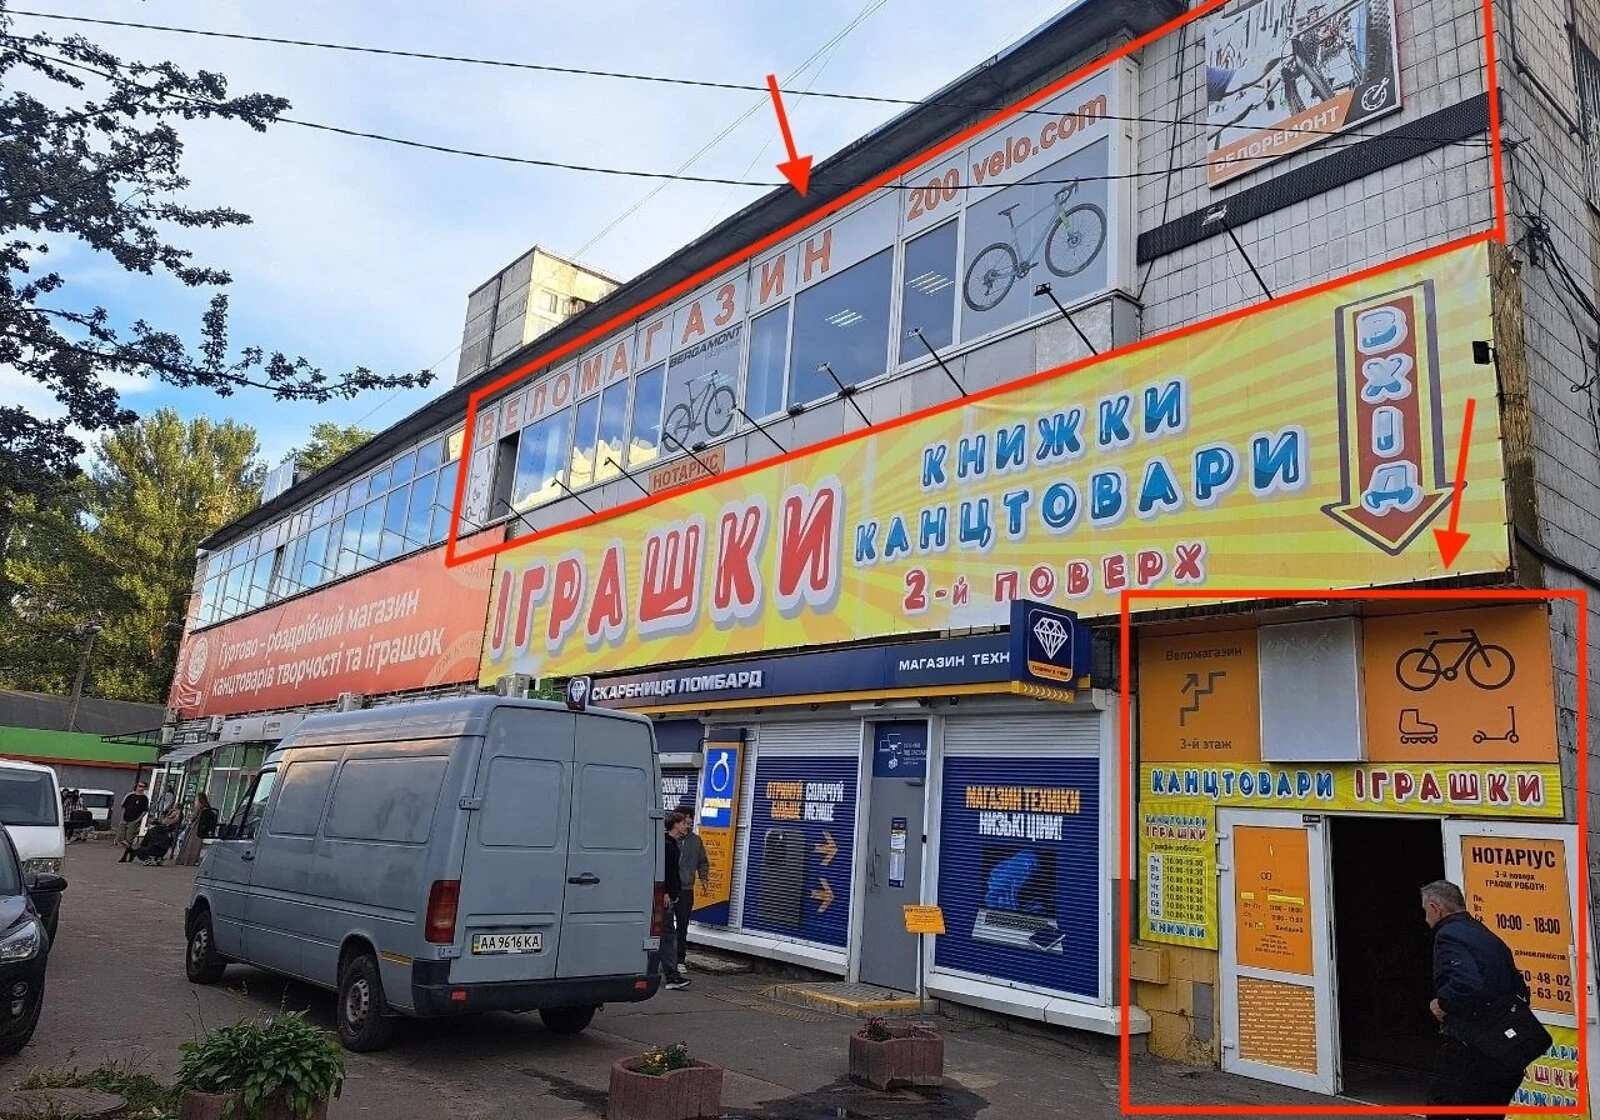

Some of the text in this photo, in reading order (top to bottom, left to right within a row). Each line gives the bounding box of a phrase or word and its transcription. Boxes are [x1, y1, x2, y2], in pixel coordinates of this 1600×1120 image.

[1213, 105, 1340, 173] ВЕЛОРЕМОНТ
[907, 94, 1108, 222] 200 velo.com
[479, 229, 833, 444] ВЕЛОМАГАЗИН
[669, 325, 743, 368] BERGAMONT
[1358, 307, 1421, 514] ВХІД
[922, 380, 1183, 488] КНИЖКИ
[855, 430, 1301, 562] КАНЦТОВАРИ
[490, 485, 838, 652] ІГРАШКИ
[904, 543, 1203, 611] 2-й ПОВЕРХ
[348, 589, 420, 630] магазин
[277, 642, 343, 689] творчості
[346, 646, 362, 673] та
[365, 628, 444, 675] іграшок
[899, 651, 1011, 671] МАГАЗИН ТЕХН
[1166, 647, 1243, 661] Веломагазин
[591, 670, 763, 701] СКАРБНИЦЯ ЛОМБАРД
[1180, 738, 1233, 750] 3-й этаж
[965, 785, 1080, 814] МАГАЗИН ТЕХНІКИ
[1151, 769, 1542, 803] КАНЦТОВАРИ ІГРАШКИ
[979, 812, 1024, 837] НИЗЬКІ
[1145, 814, 1208, 826] КАНЦТОВАРИ
[1146, 825, 1206, 841] ІГРАШКИ
[1472, 847, 1556, 869] НОТАРІУС
[1485, 880, 1547, 891] ГРАФІК РОБОТИ:
[1150, 922, 1205, 938] КНИЖКИ
[1495, 913, 1522, 931] 10:00
[1533, 917, 1561, 935] 18:00
[481, 935, 540, 949] AA 9616 KA
